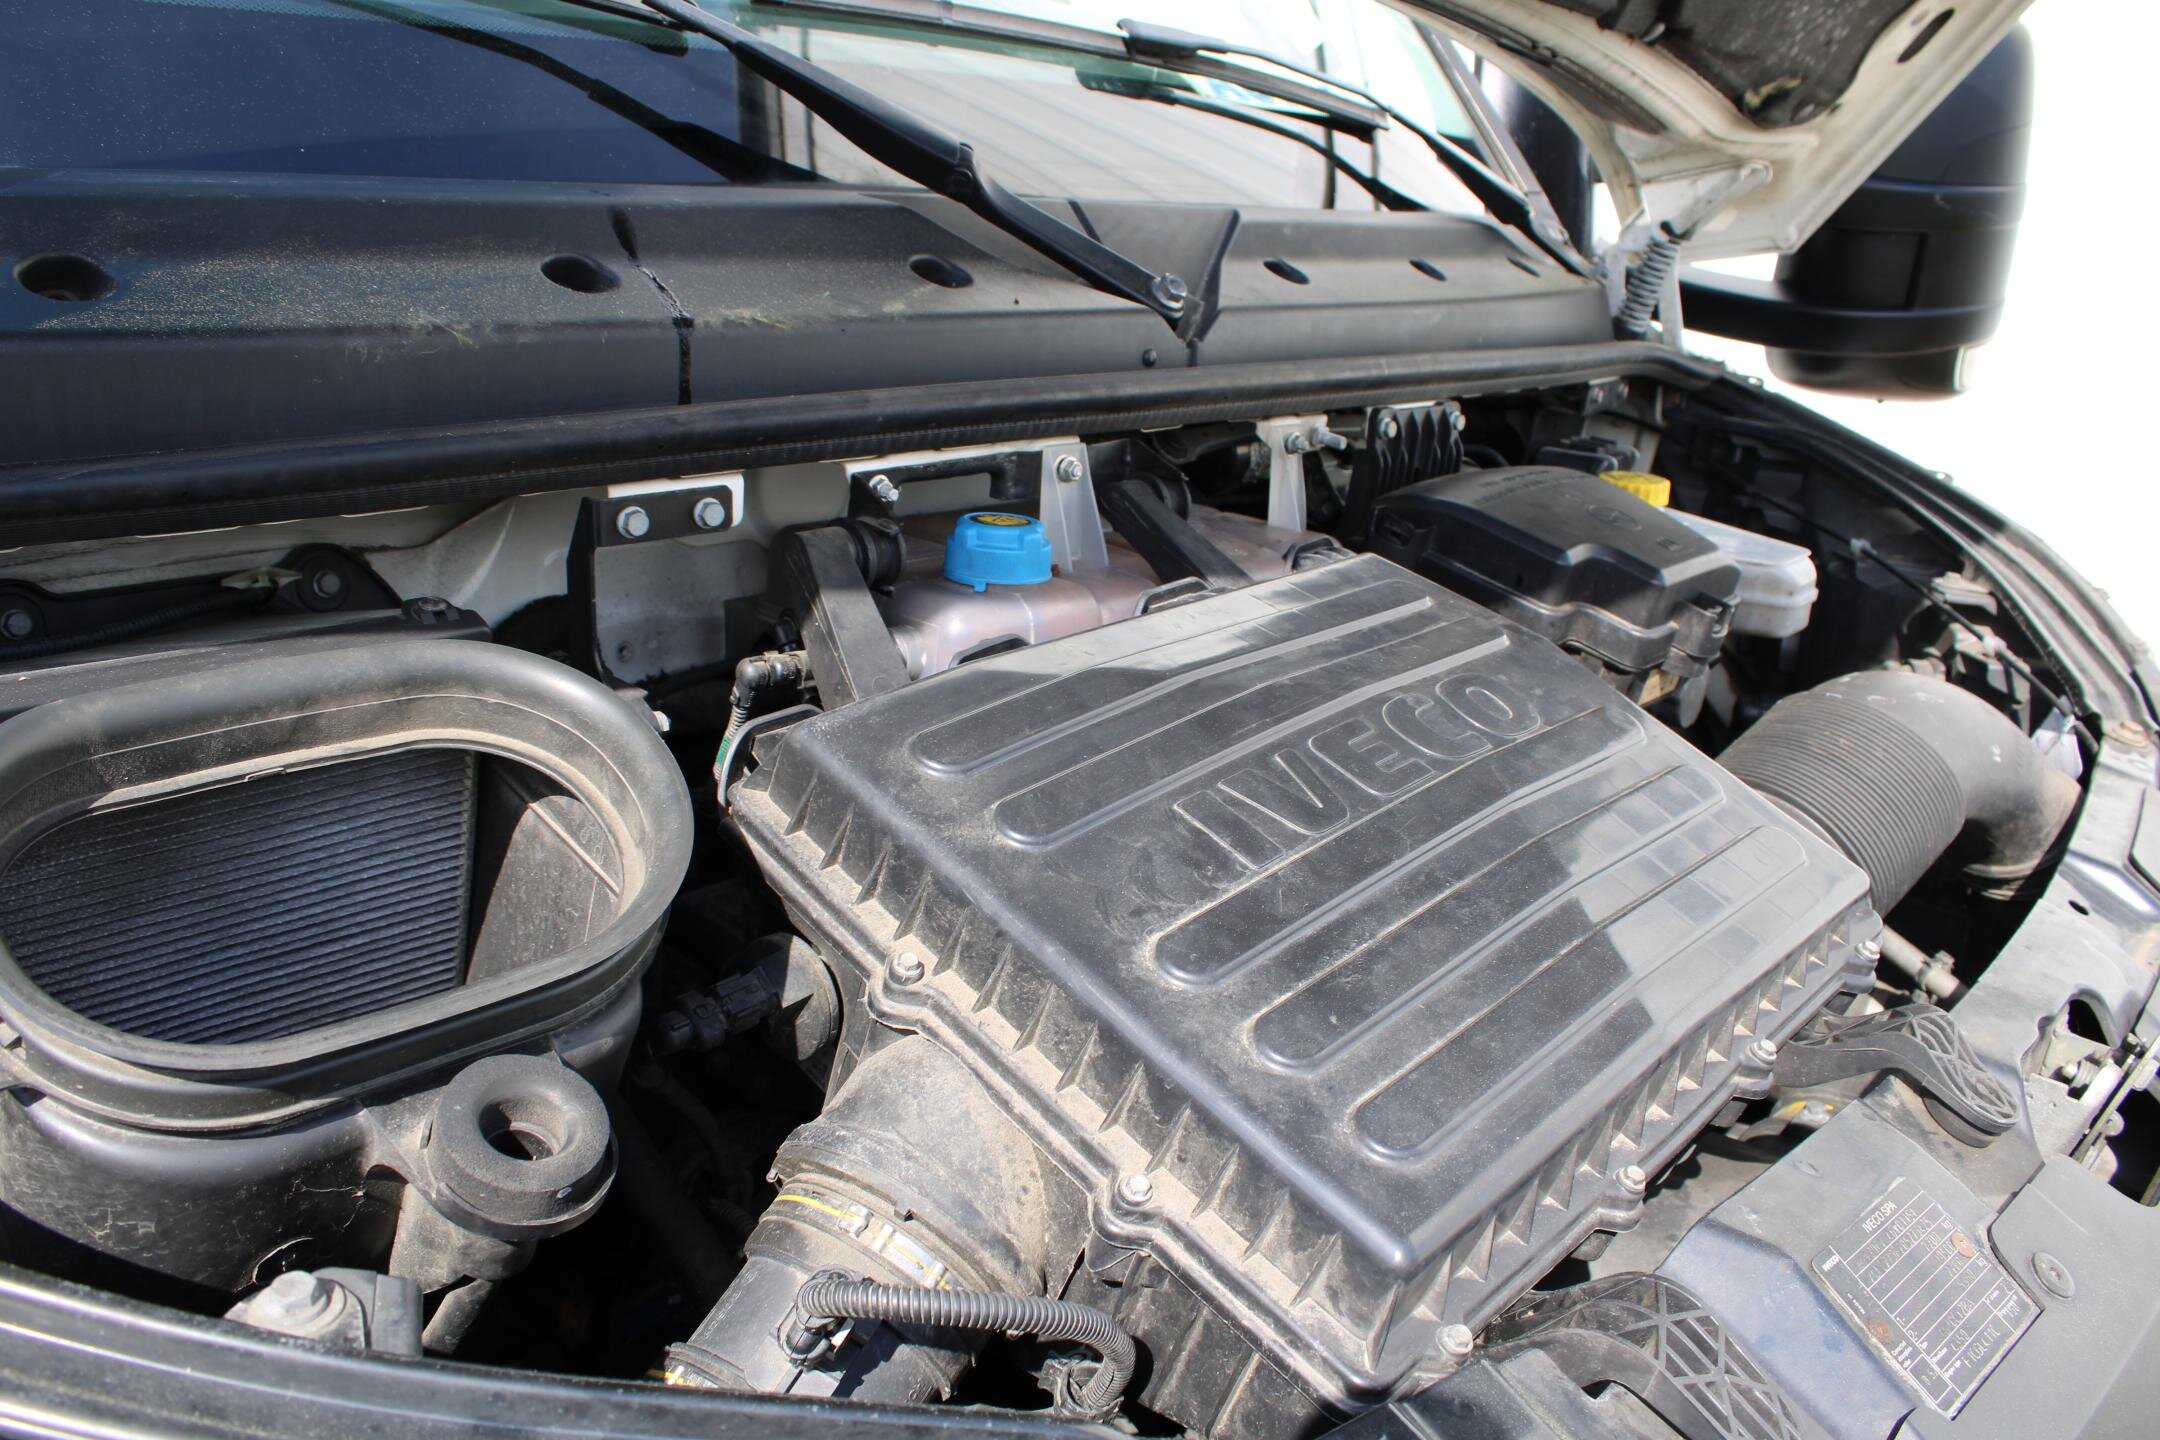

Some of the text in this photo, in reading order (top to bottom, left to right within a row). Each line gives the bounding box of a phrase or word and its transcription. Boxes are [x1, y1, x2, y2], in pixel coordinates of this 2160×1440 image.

[1174, 673, 1542, 870] IVECO
[1861, 1199, 1897, 1233] IVECO SPA
[1821, 1253, 1840, 1272] IVECO
